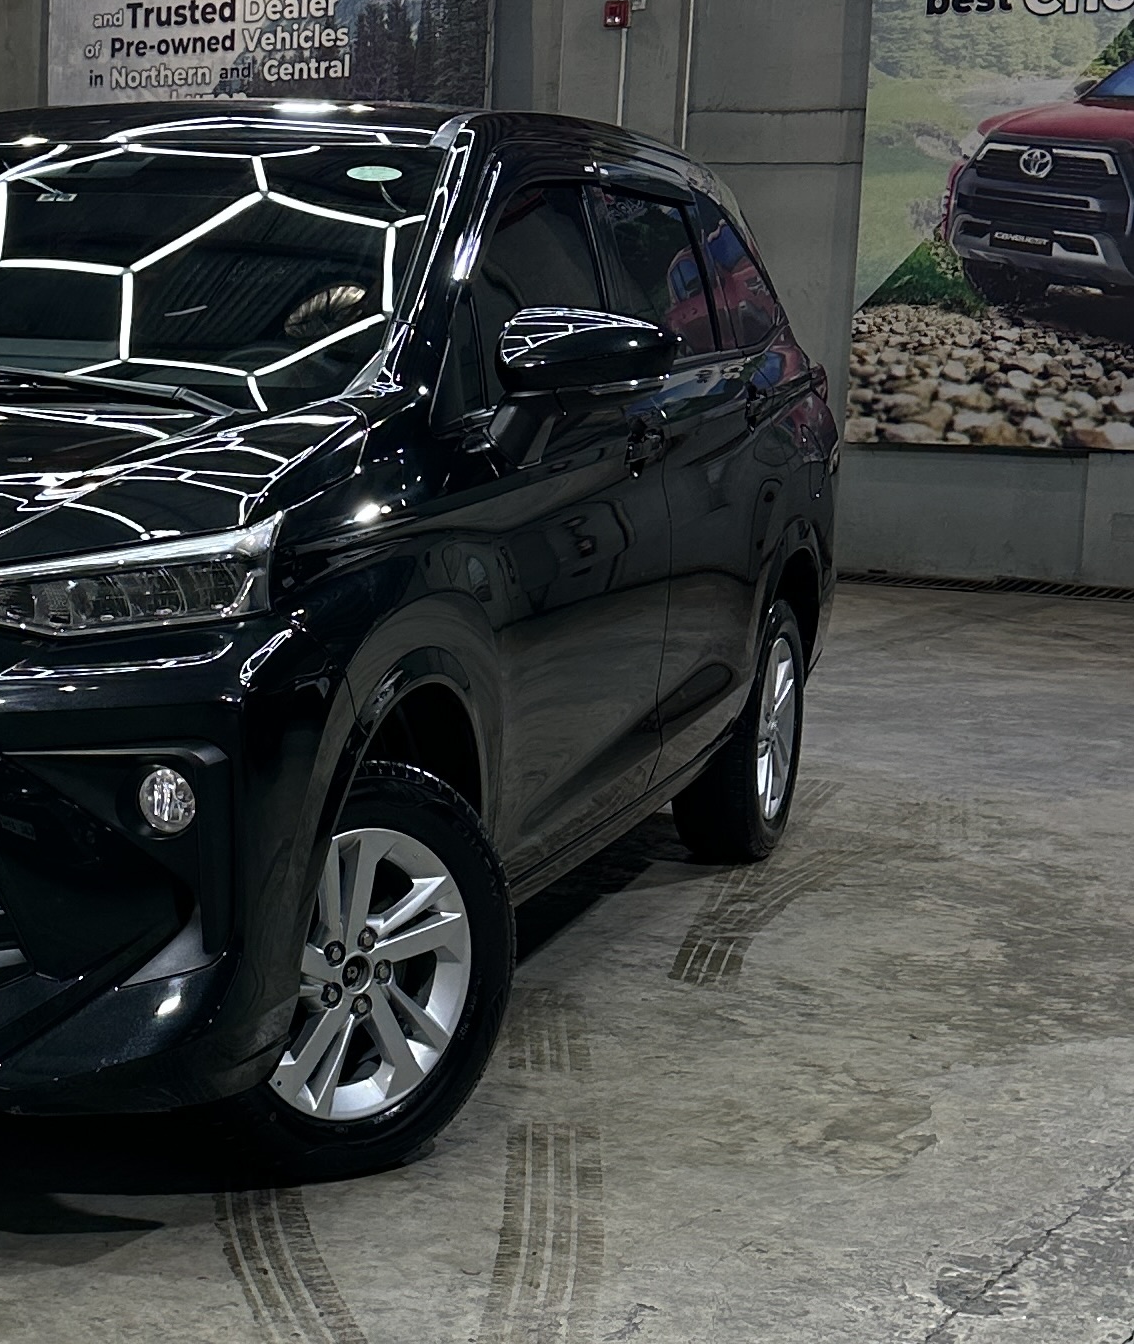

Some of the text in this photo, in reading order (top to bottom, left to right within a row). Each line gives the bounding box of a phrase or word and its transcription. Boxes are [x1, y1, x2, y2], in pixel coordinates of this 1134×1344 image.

[93, 8, 124, 28] and
[84, 23, 349, 59] of Pre-owned Vehicles
[89, 53, 351, 90] in Northern and Central
